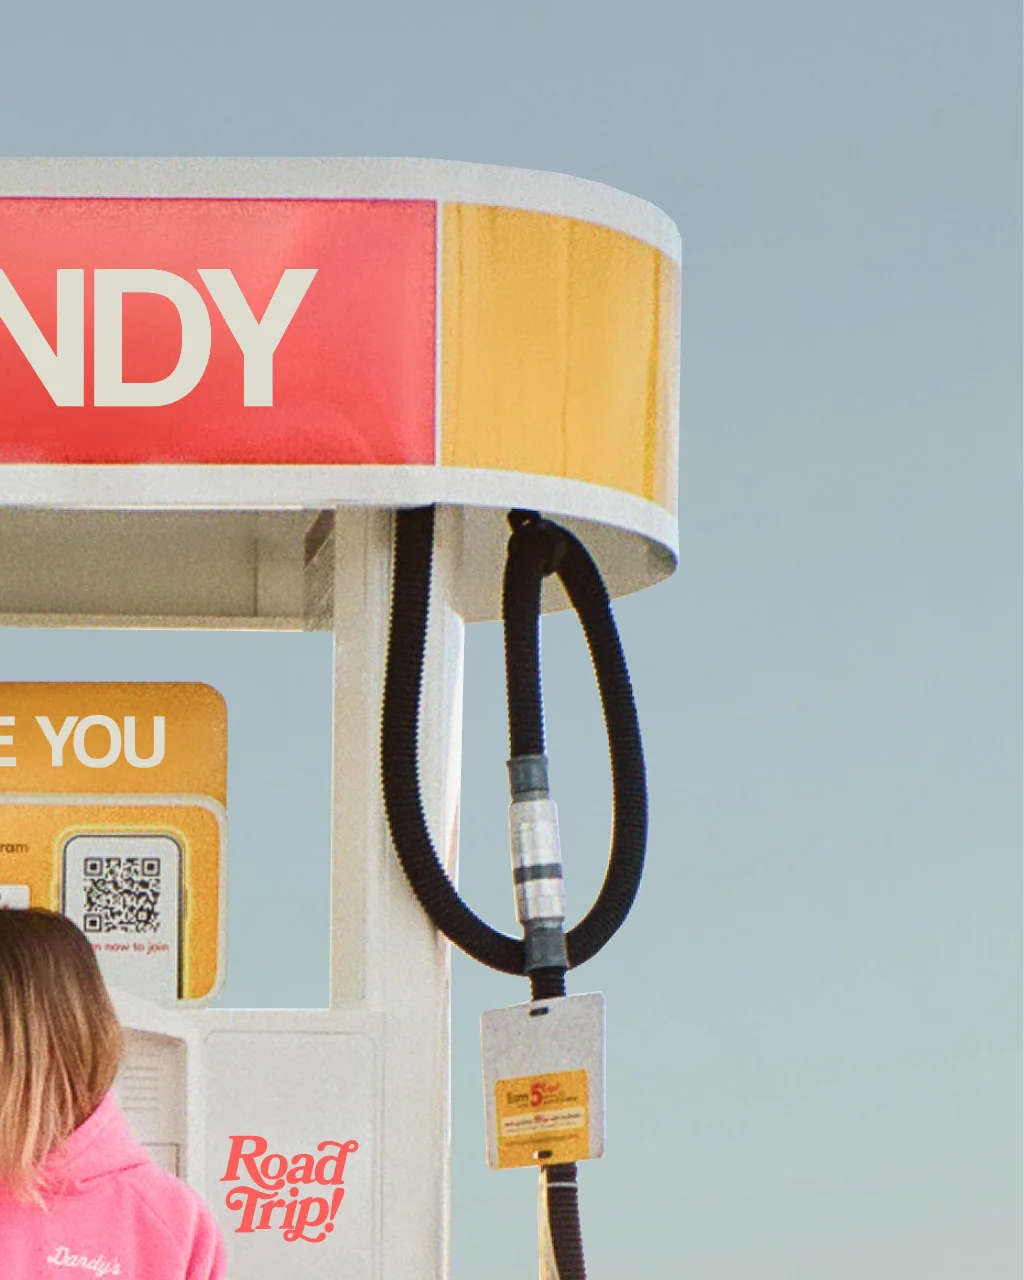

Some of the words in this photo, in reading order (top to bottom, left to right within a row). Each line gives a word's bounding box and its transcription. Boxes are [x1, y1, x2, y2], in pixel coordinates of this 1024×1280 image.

[35, 714, 166, 769] YOU
[105, 943, 130, 951] now
[133, 942, 145, 951] to
[147, 942, 170, 954] join
[219, 1135, 359, 1191] Road
[225, 1186, 345, 1243] Trip!
[47, 1245, 122, 1277] Dandy's
